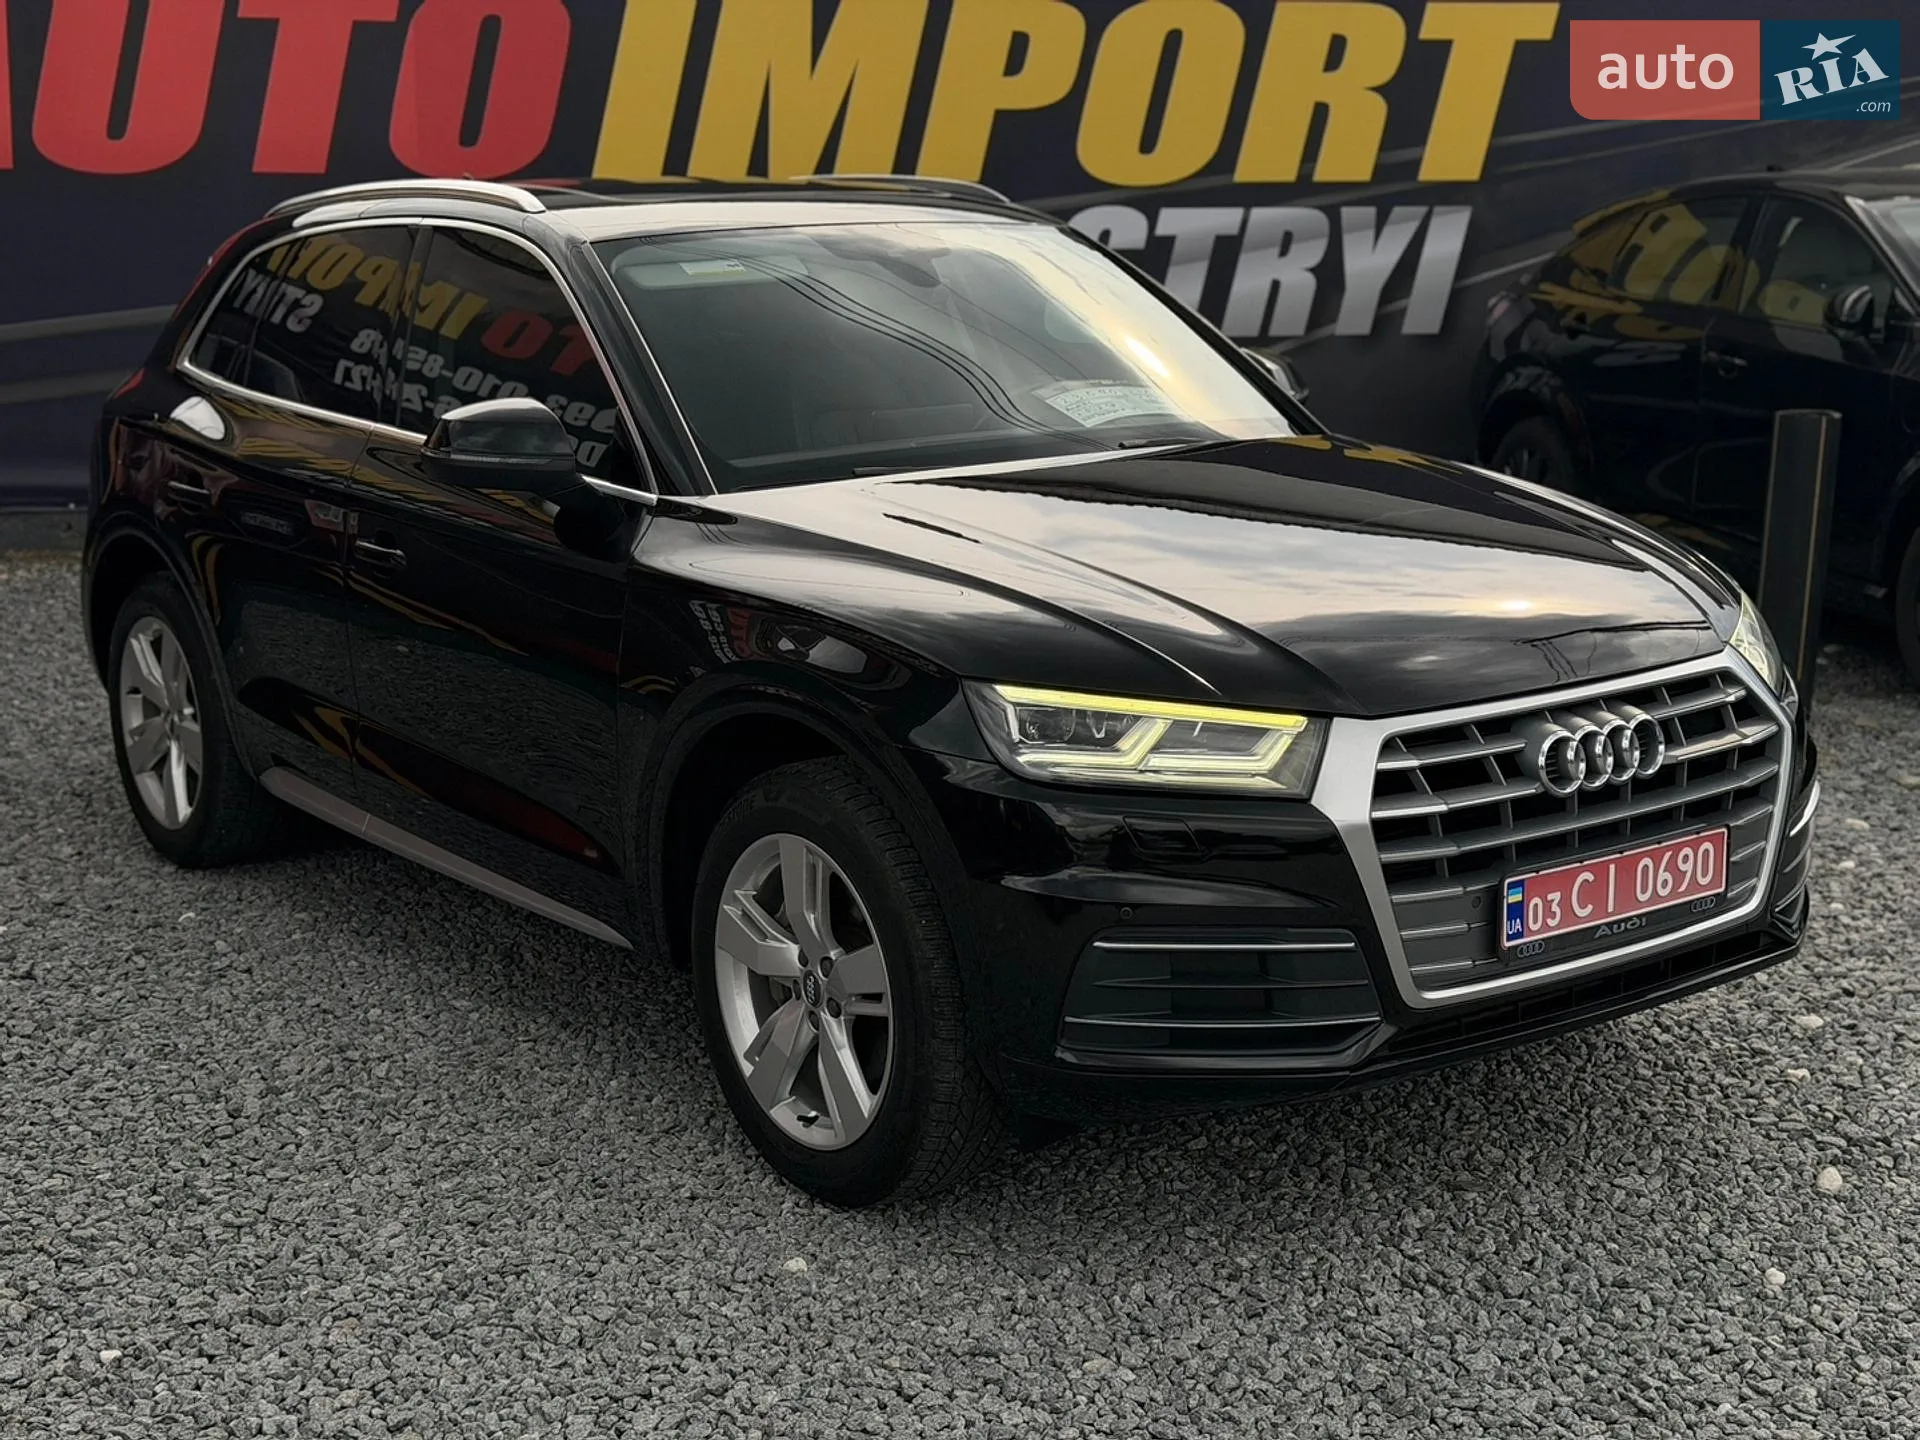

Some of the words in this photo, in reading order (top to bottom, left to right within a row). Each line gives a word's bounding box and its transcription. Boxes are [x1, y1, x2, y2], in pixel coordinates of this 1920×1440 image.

[0, 0, 572, 180] UTO
[592, 0, 1561, 188] IMPORT
[1507, 918, 1522, 934] UA
[1593, 917, 1647, 938] Audi
